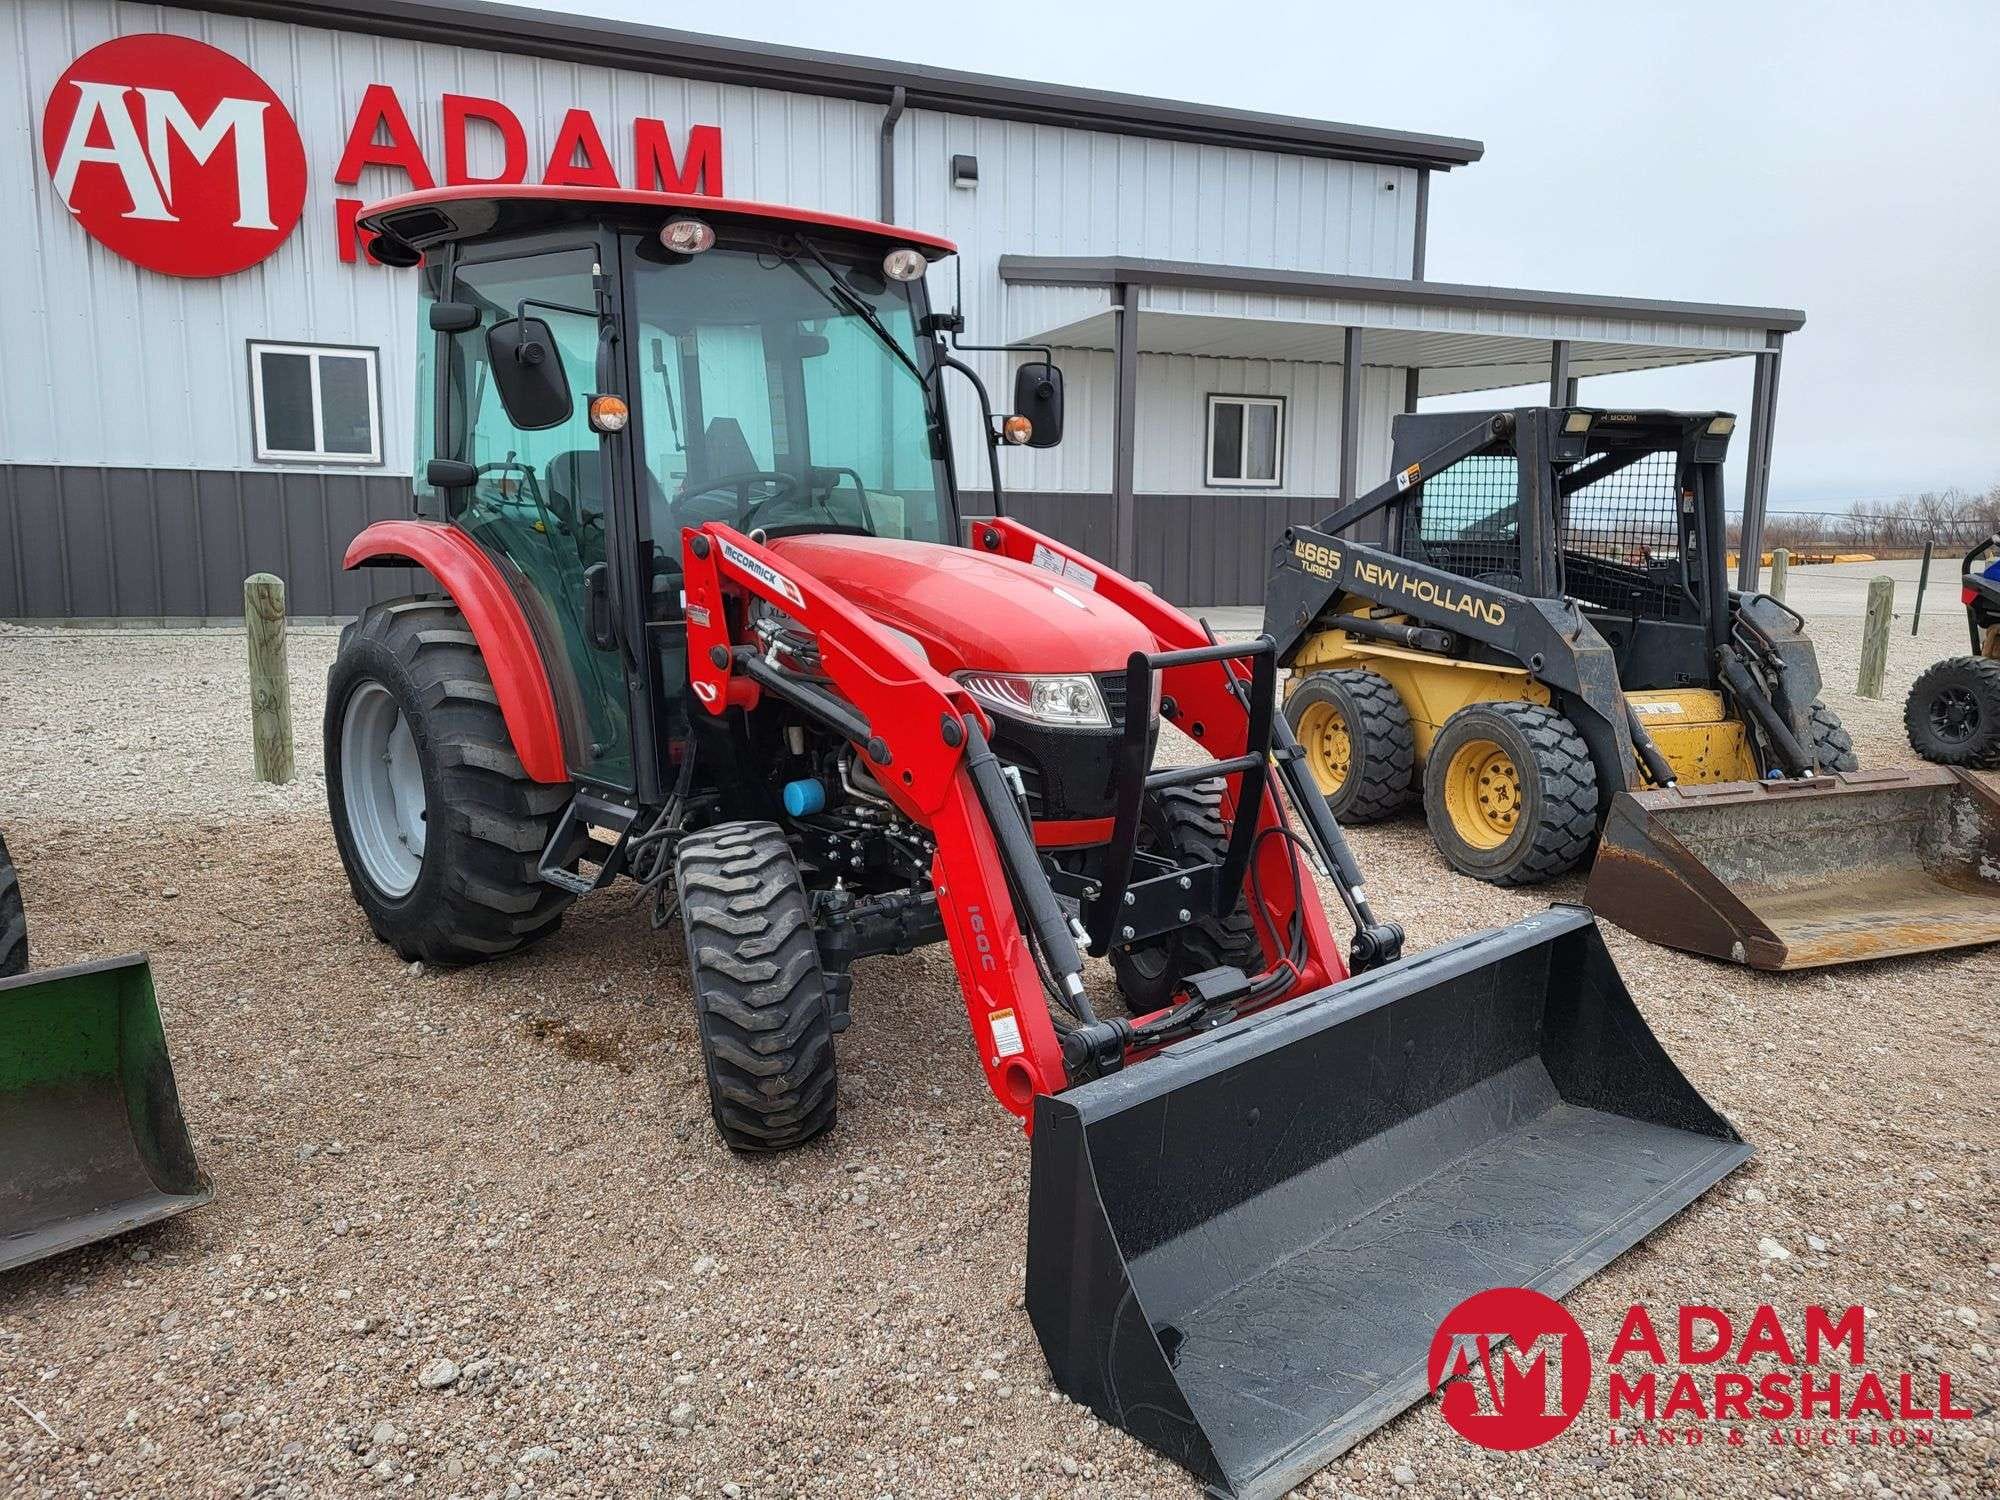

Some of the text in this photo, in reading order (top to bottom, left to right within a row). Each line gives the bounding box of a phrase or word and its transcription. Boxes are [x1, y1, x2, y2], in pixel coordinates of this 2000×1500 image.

[53, 80, 279, 231] AM
[334, 83, 724, 198] ADAM
[1301, 560, 1333, 579] TURBO
[1354, 559, 1506, 626] NEW HOLLAND
